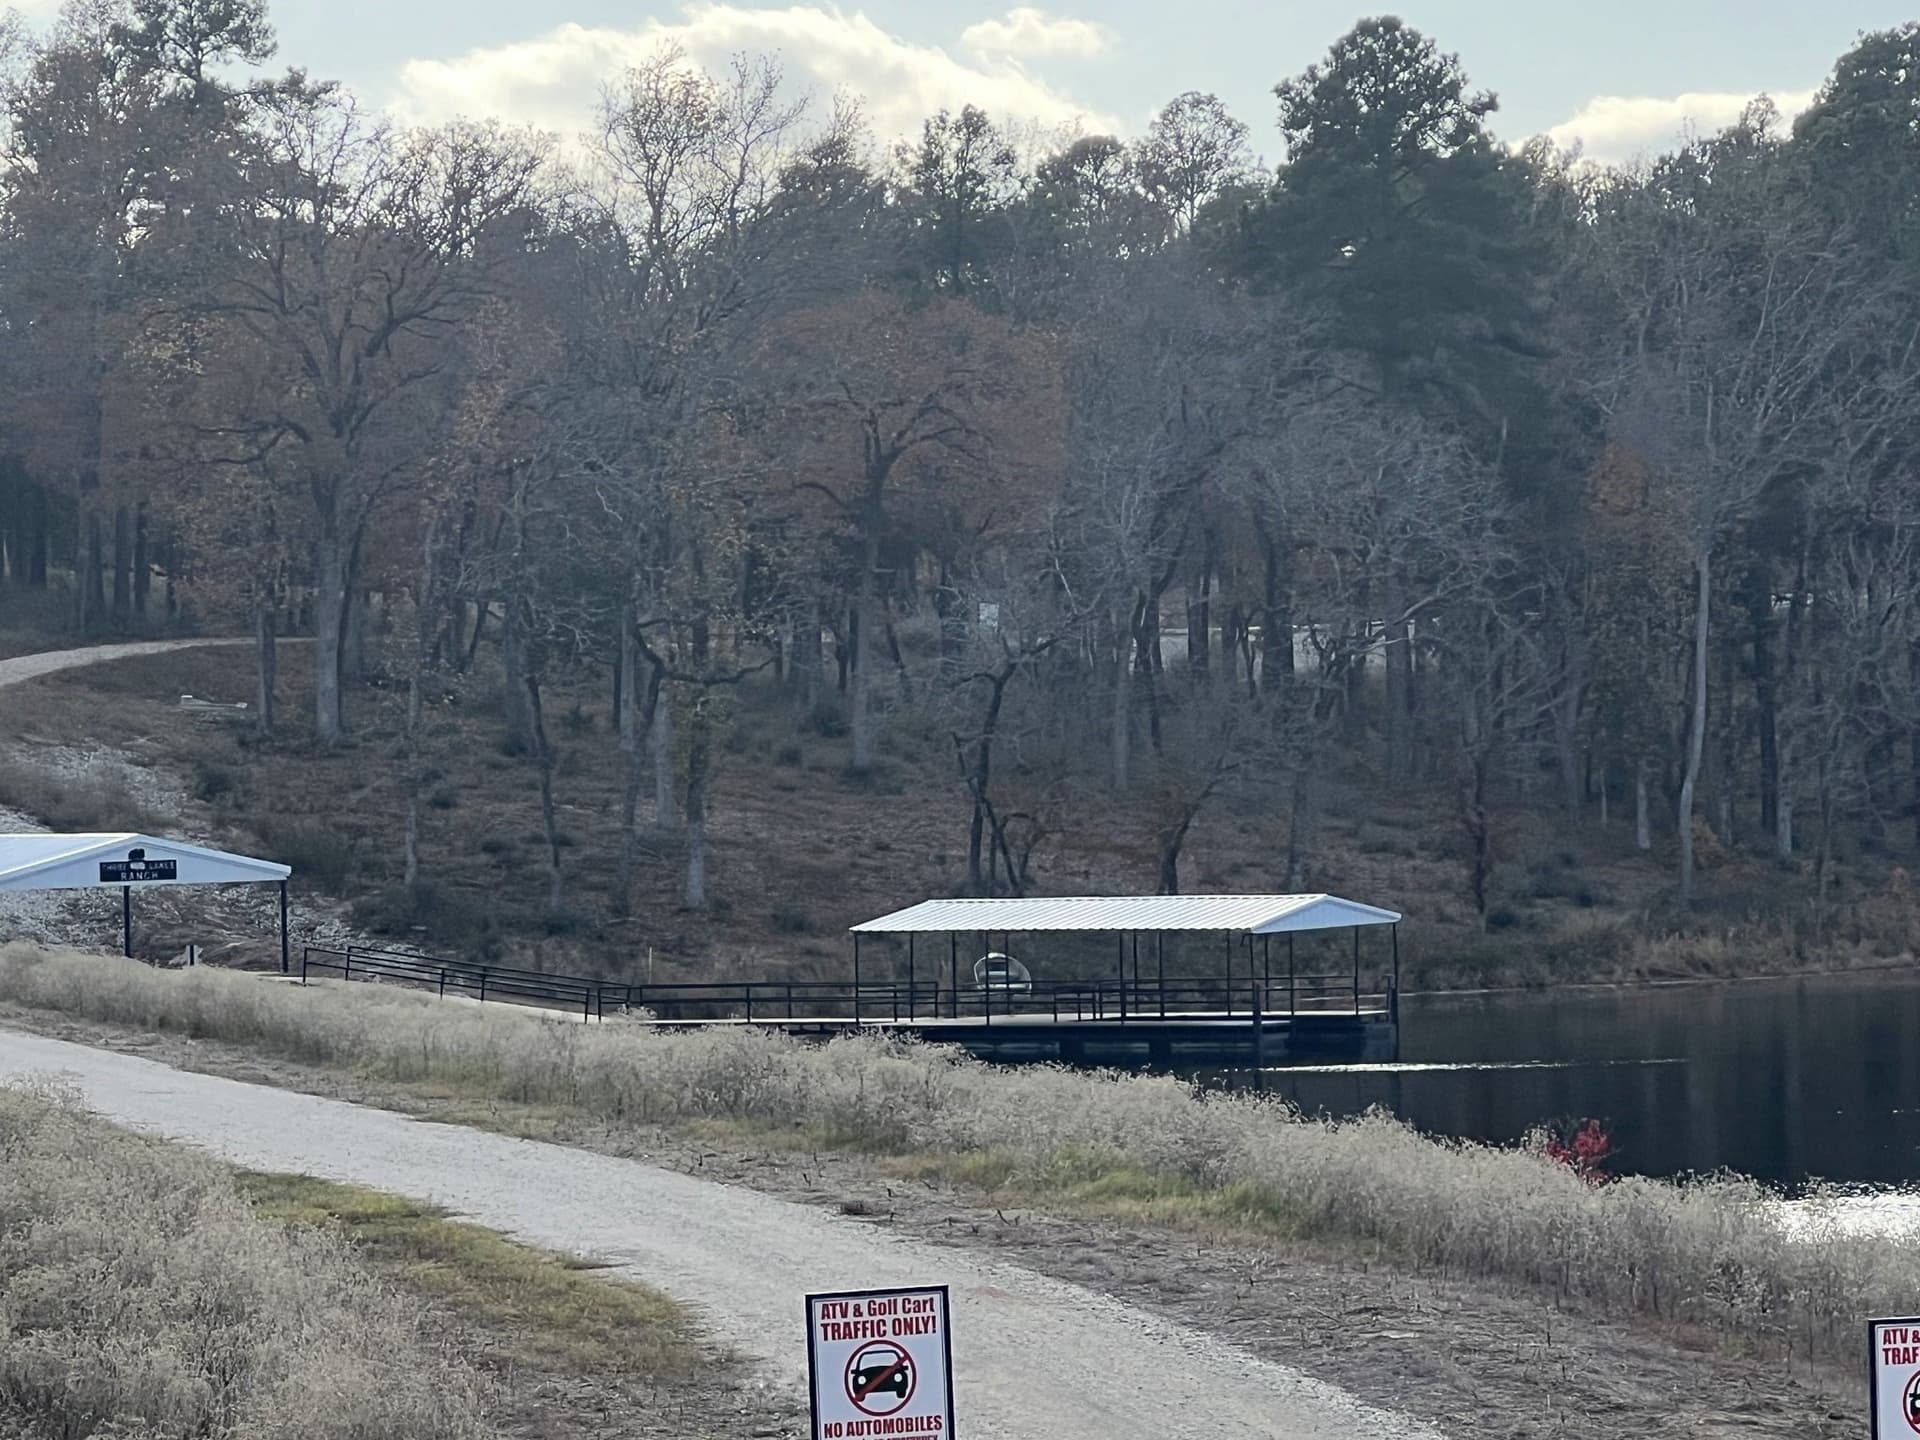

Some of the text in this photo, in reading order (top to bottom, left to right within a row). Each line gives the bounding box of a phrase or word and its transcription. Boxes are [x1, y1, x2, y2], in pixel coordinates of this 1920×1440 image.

[120, 871, 158, 880] RANCH
[821, 1302, 848, 1320] ATV
[853, 1303, 863, 1318] &
[902, 1297, 935, 1315] Cart
[821, 1315, 937, 1341] TRAFFIC ONLY!
[1883, 1328, 1908, 1345] ATV
[824, 1414, 943, 1438] NO AUTOMOBILES
